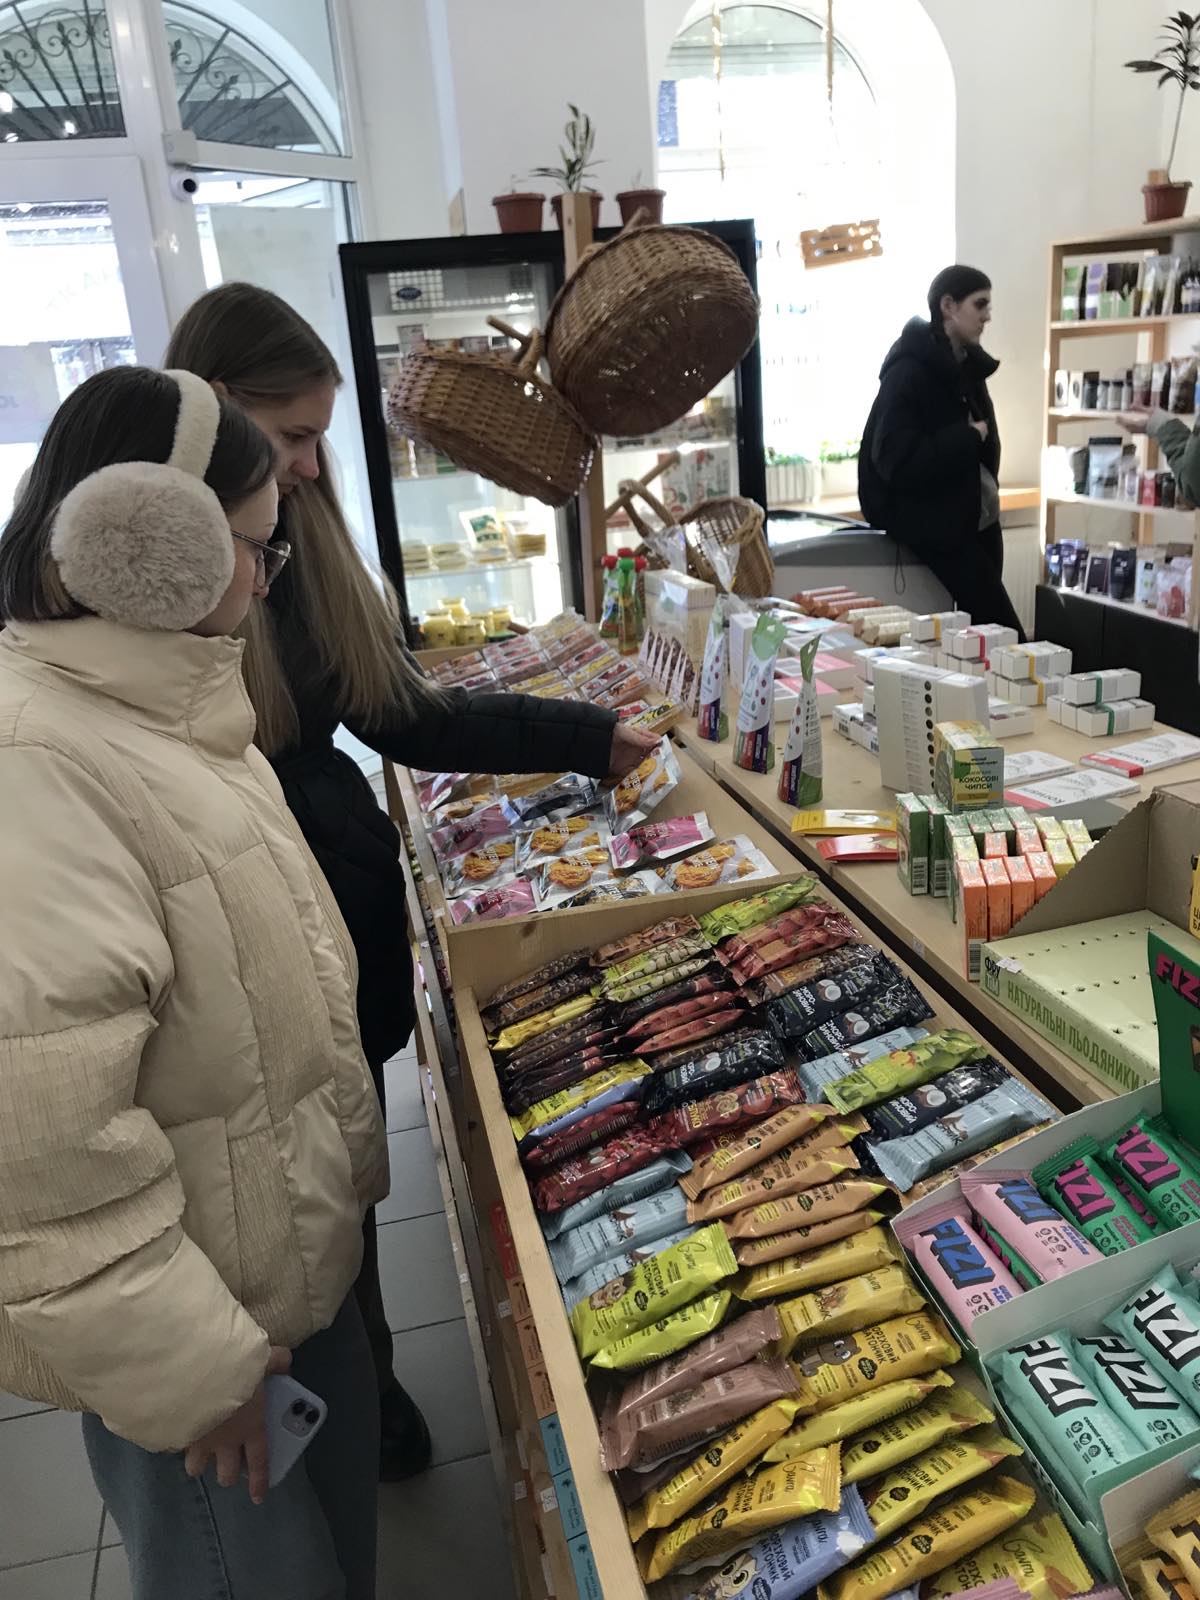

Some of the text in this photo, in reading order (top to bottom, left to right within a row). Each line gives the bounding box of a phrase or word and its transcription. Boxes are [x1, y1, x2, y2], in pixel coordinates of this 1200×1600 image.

[1007, 980, 1140, 1090] НАТУРАЛЬНІ ЛЬОДЯНИКИ
[889, 1099, 917, 1124] ИНОВИЙ
[991, 1287, 1006, 1304] PLEA
[999, 1285, 1013, 1300] GUIL
[870, 1324, 901, 1364] ОРІХОВИЙ
[1077, 1335, 1180, 1410] FIZI
[895, 1467, 925, 1491] АТОНЧИК
[905, 1462, 938, 1487] ОРІХОВИЙ
[769, 1531, 795, 1580] ОРІХОВИЙ
